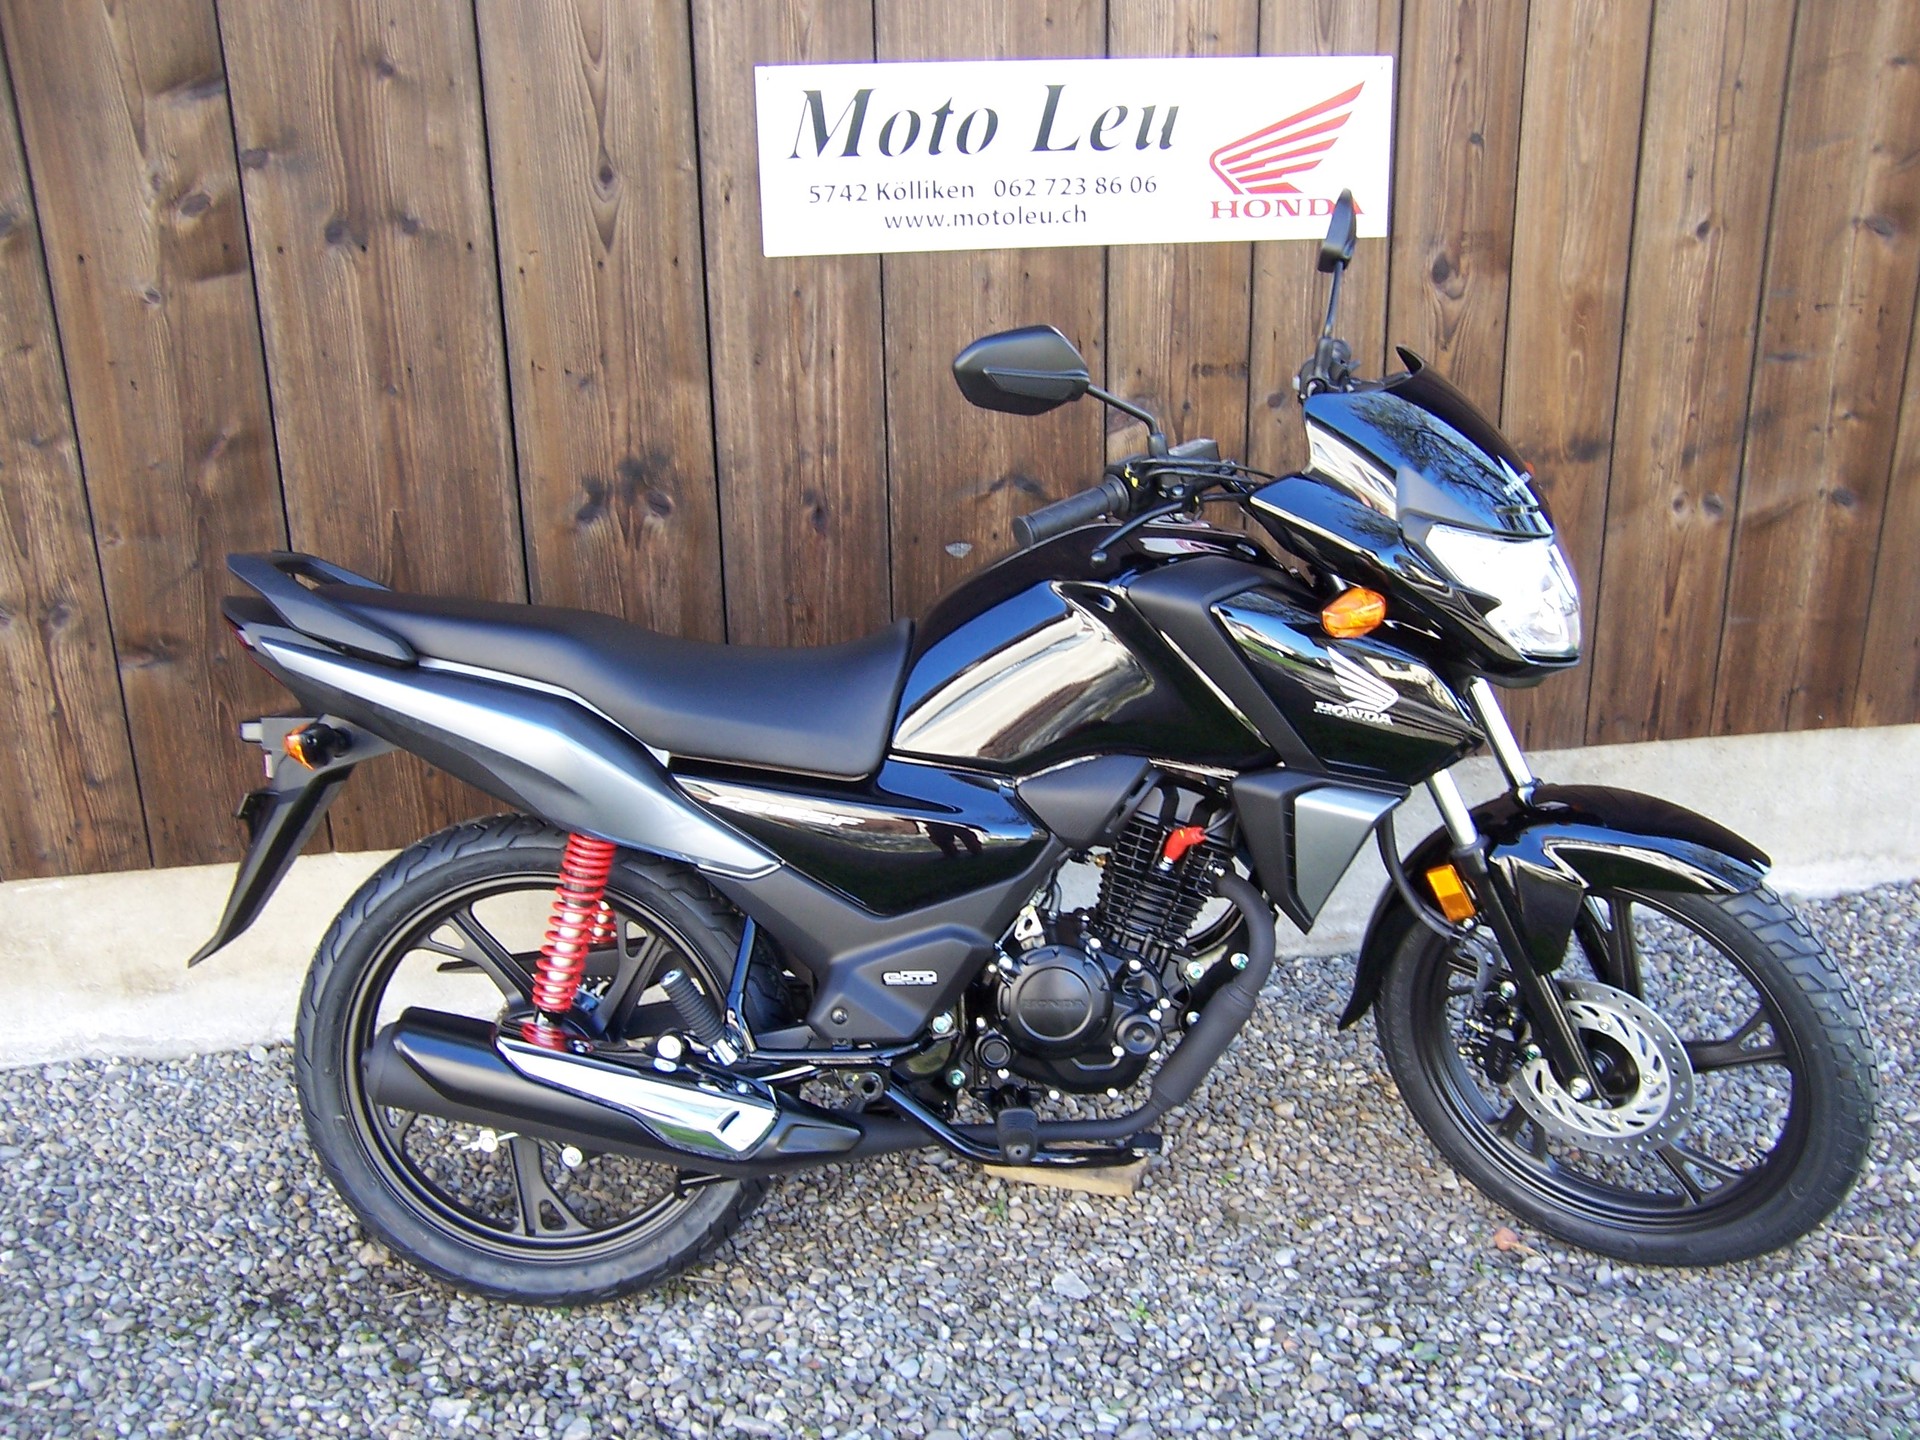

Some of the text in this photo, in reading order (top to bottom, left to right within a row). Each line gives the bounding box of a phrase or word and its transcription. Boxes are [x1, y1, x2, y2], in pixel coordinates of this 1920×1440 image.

[788, 84, 1180, 159] Moto Leu
[809, 176, 1157, 203] 5742 Kölliken 062 723 86 06
[884, 206, 1087, 230] www.motoleu.ch
[1314, 701, 1393, 726] HONDA
